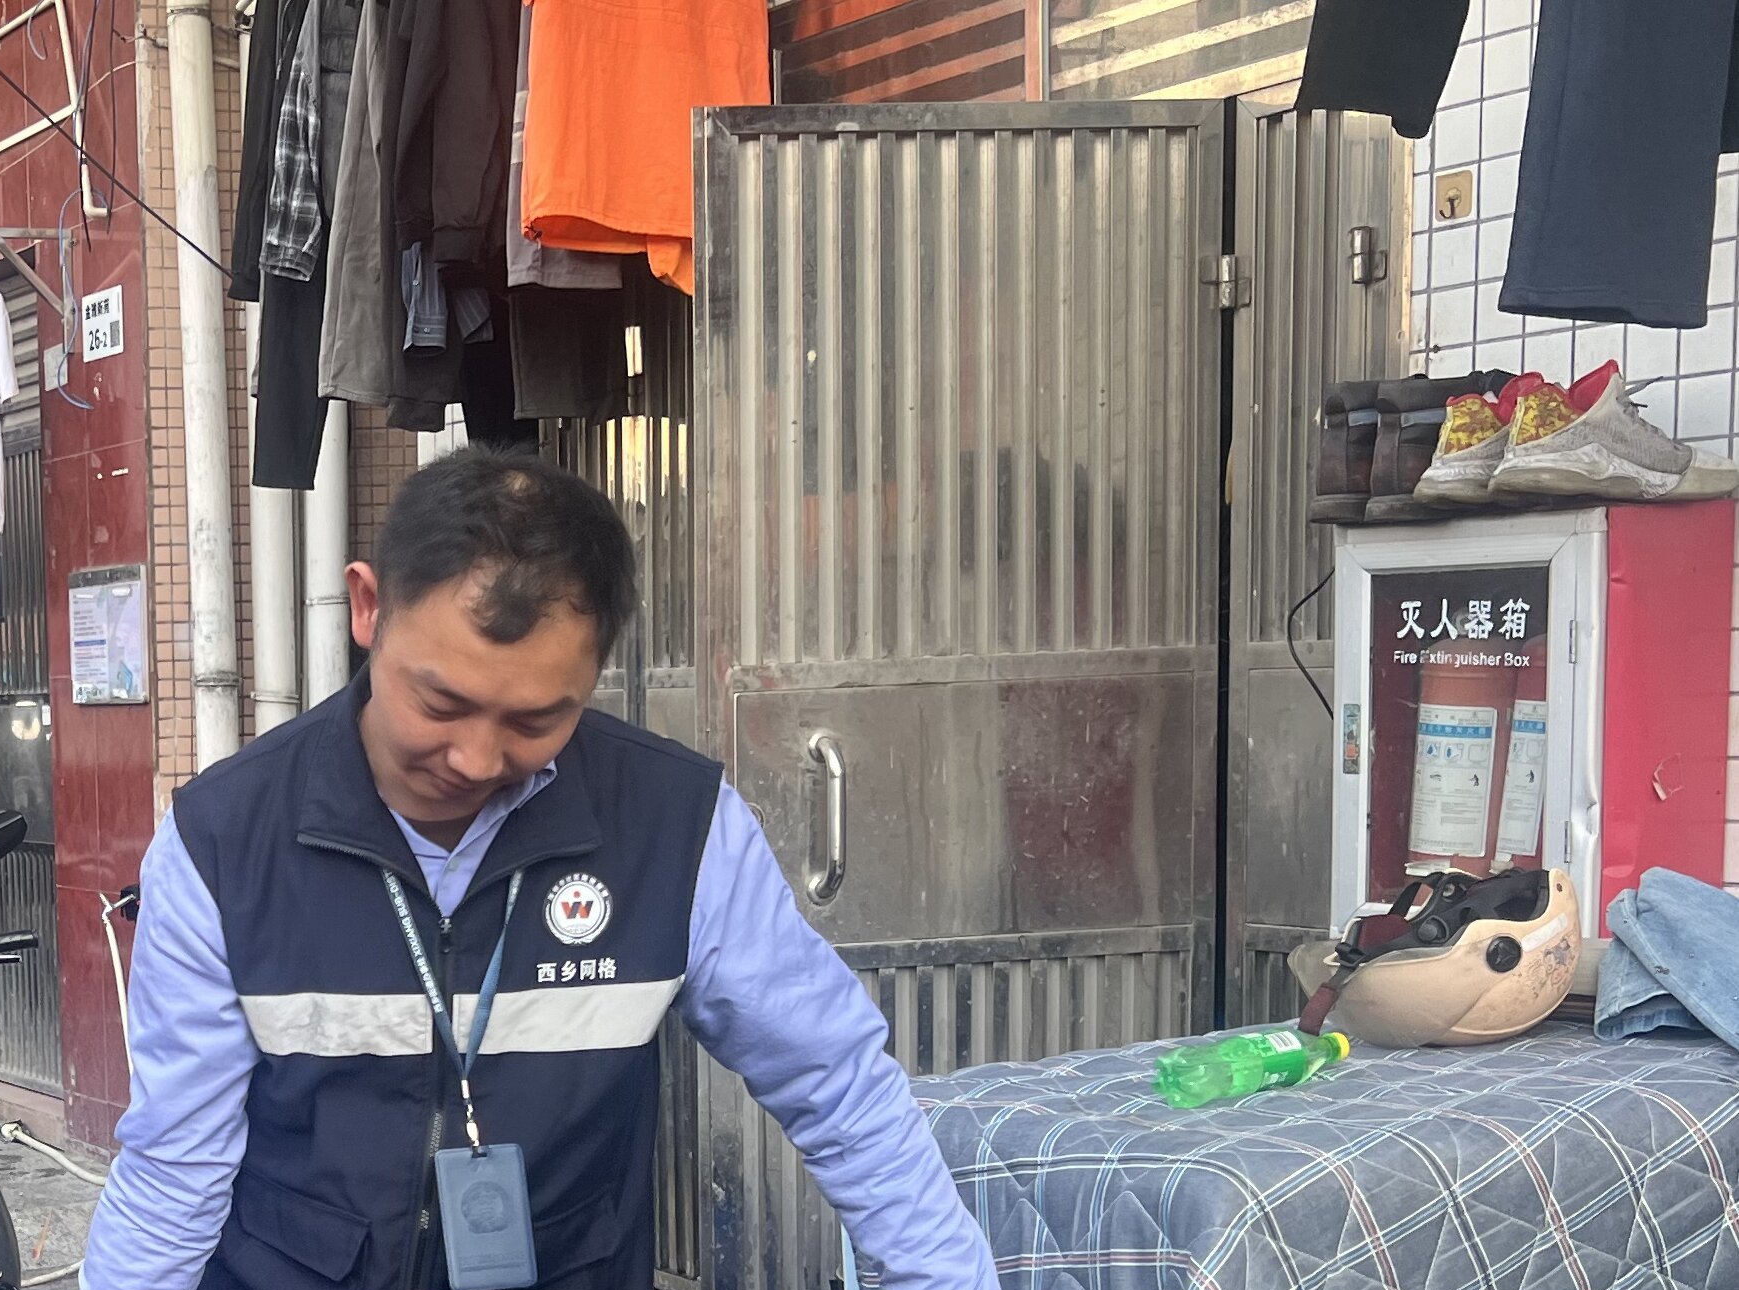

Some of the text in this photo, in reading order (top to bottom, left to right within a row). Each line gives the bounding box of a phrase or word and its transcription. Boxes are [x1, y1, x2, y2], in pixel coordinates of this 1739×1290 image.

[89, 328, 108, 351] 26-2
[1393, 650, 1418, 664] Fire
[1504, 652, 1530, 667] Box
[401, 916, 423, 957] XIXIANG
[536, 957, 617, 983] 西乡网格
